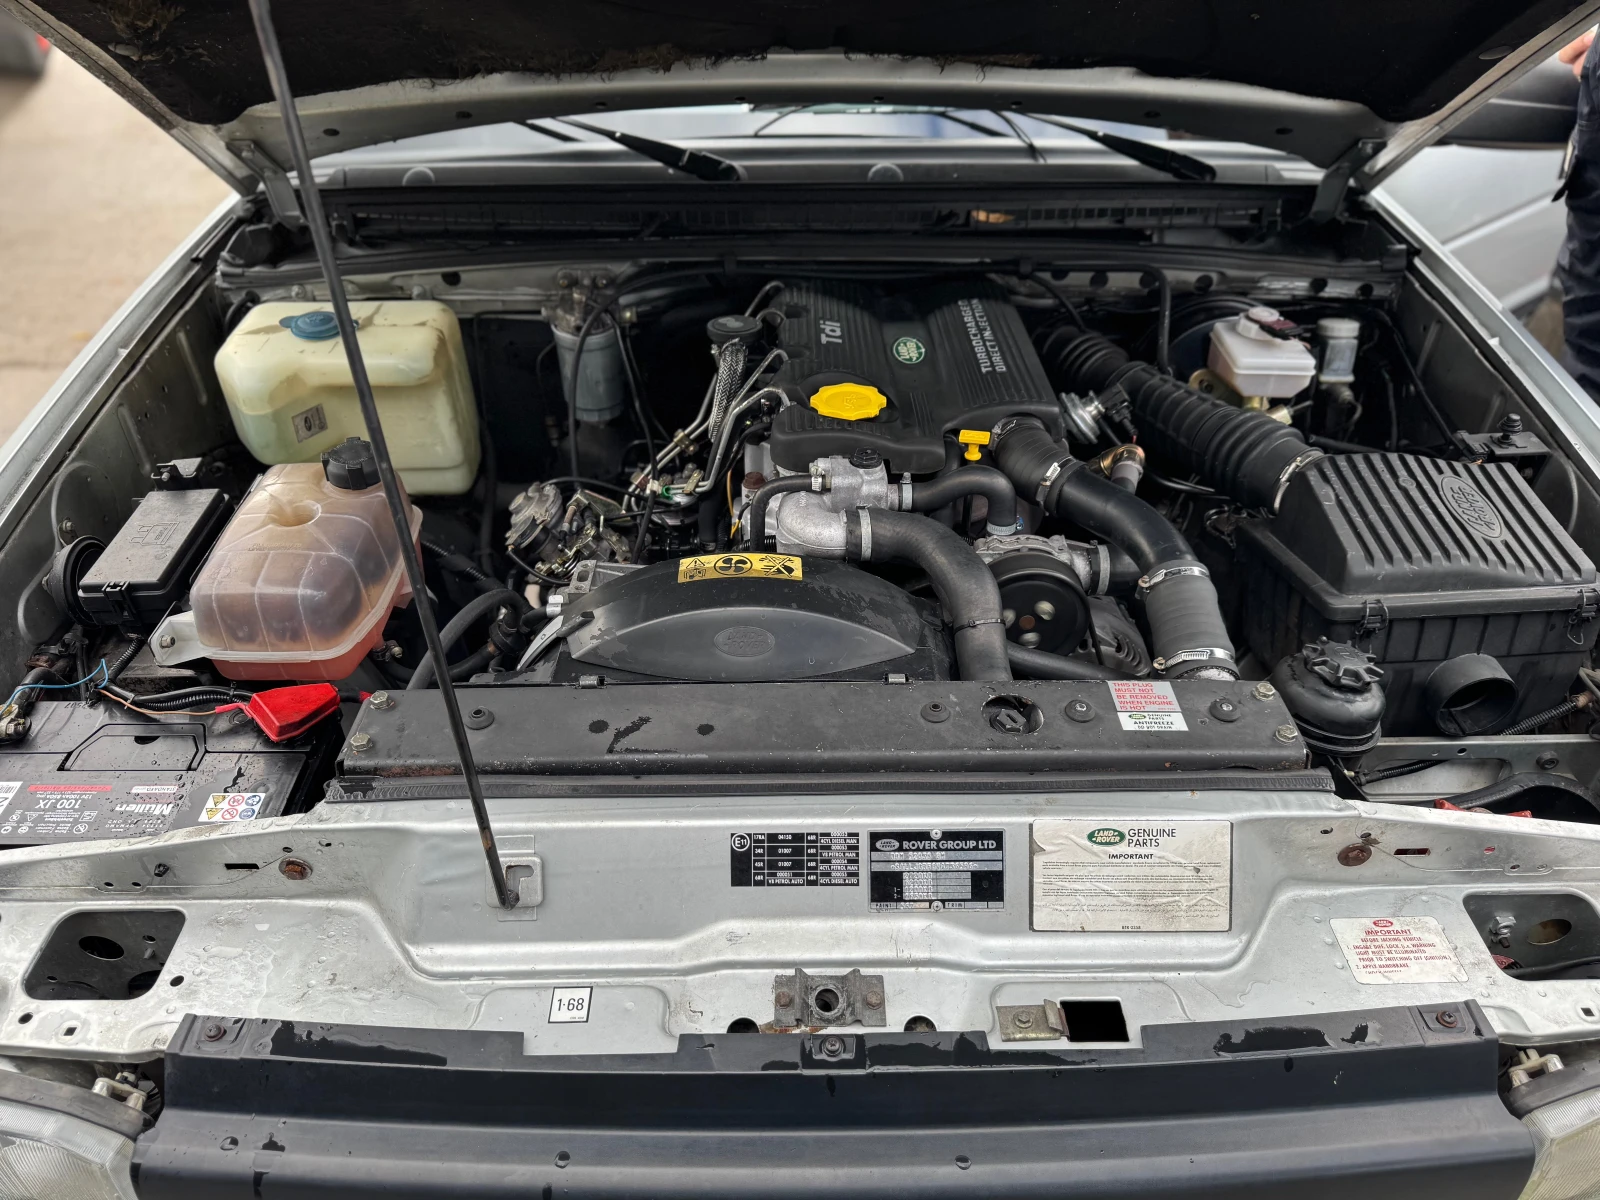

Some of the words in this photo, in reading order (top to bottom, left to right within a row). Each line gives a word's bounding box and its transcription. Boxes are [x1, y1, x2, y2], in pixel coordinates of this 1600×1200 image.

[970, 298, 994, 340] INJECTION
[820, 320, 842, 345] Tdi
[986, 341, 1006, 373] DIRECT
[35, 800, 56, 808] JX
[56, 800, 81, 808] 100
[1128, 829, 1176, 837] GENUINE
[735, 838, 746, 847] E11
[903, 841, 937, 849] ROVER
[939, 841, 976, 849] GROUP
[979, 840, 996, 849] LTD
[1128, 839, 1159, 847] PARTS
